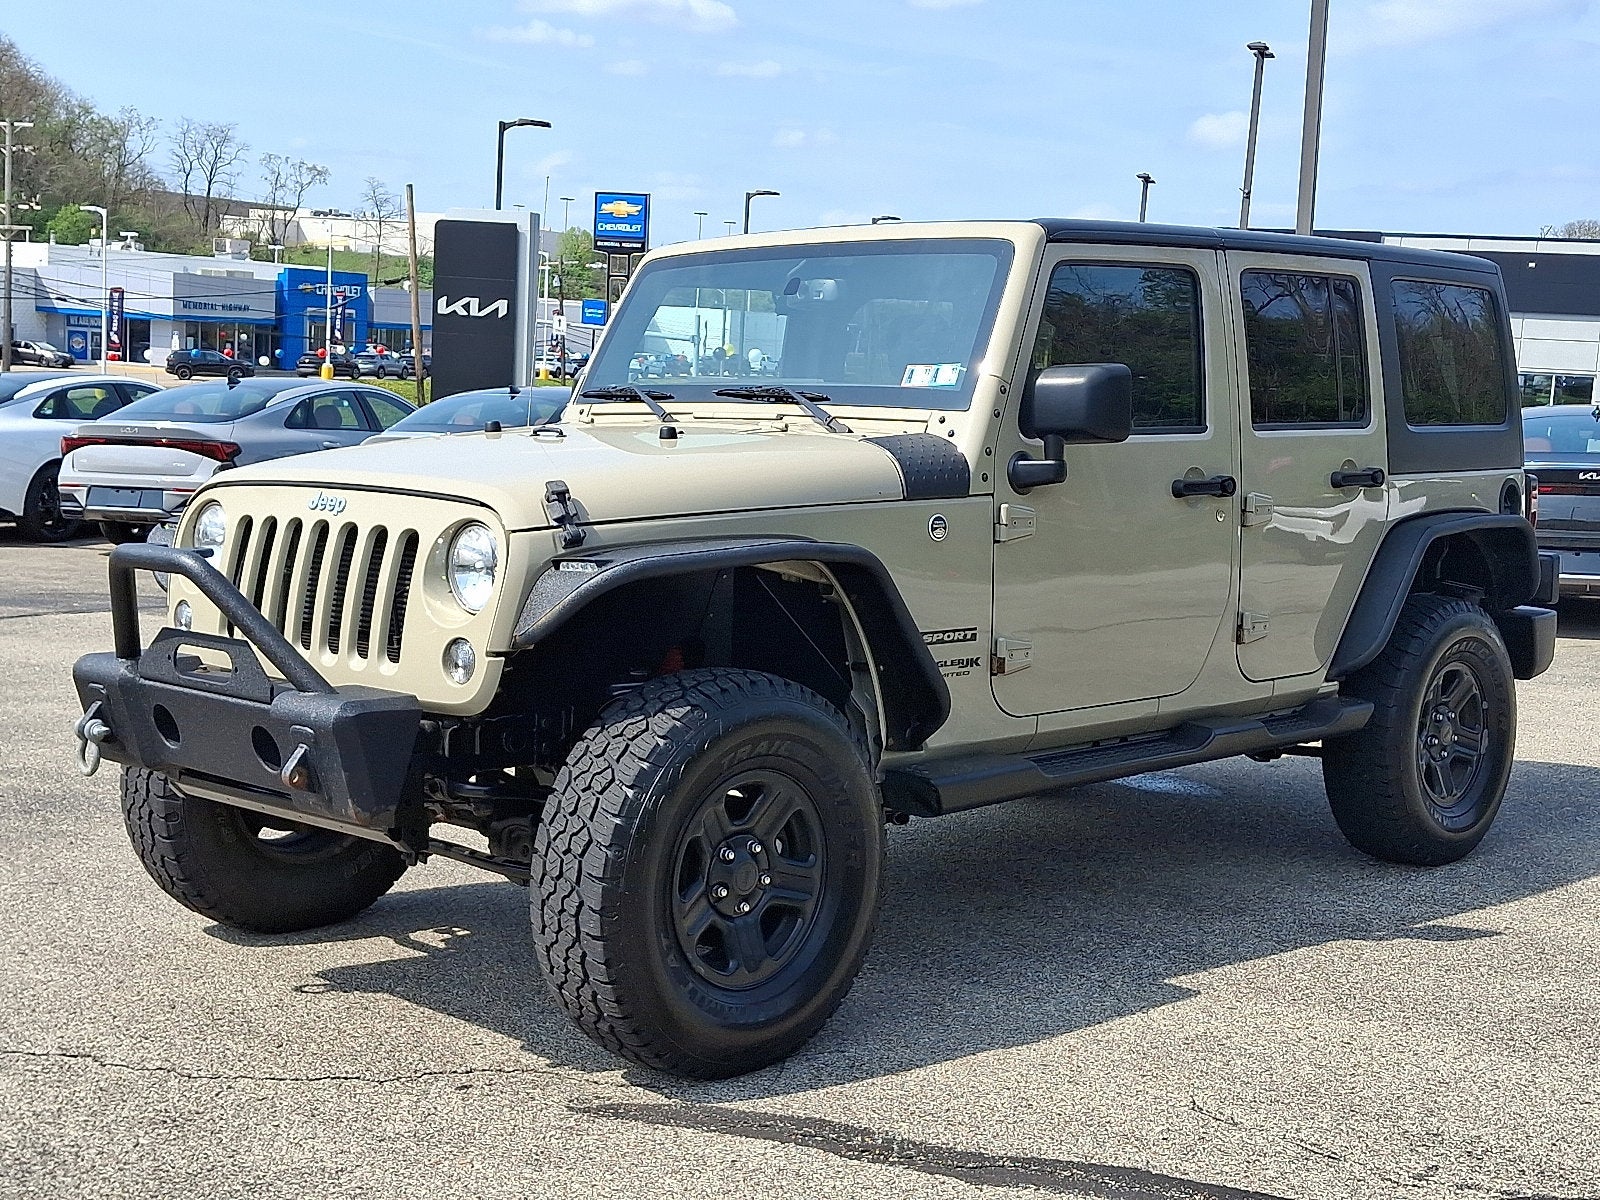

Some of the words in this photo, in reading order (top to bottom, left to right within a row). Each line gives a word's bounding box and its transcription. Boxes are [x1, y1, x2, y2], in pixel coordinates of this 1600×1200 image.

[597, 222, 643, 232] CHEVROLET
[315, 284, 362, 297] CHVROLET
[182, 300, 218, 311] MEMORIAL
[221, 303, 251, 312] HIGHWAY
[437, 295, 509, 319] KIA
[308, 490, 347, 516] Jeep
[922, 631, 972, 643] SPORT
